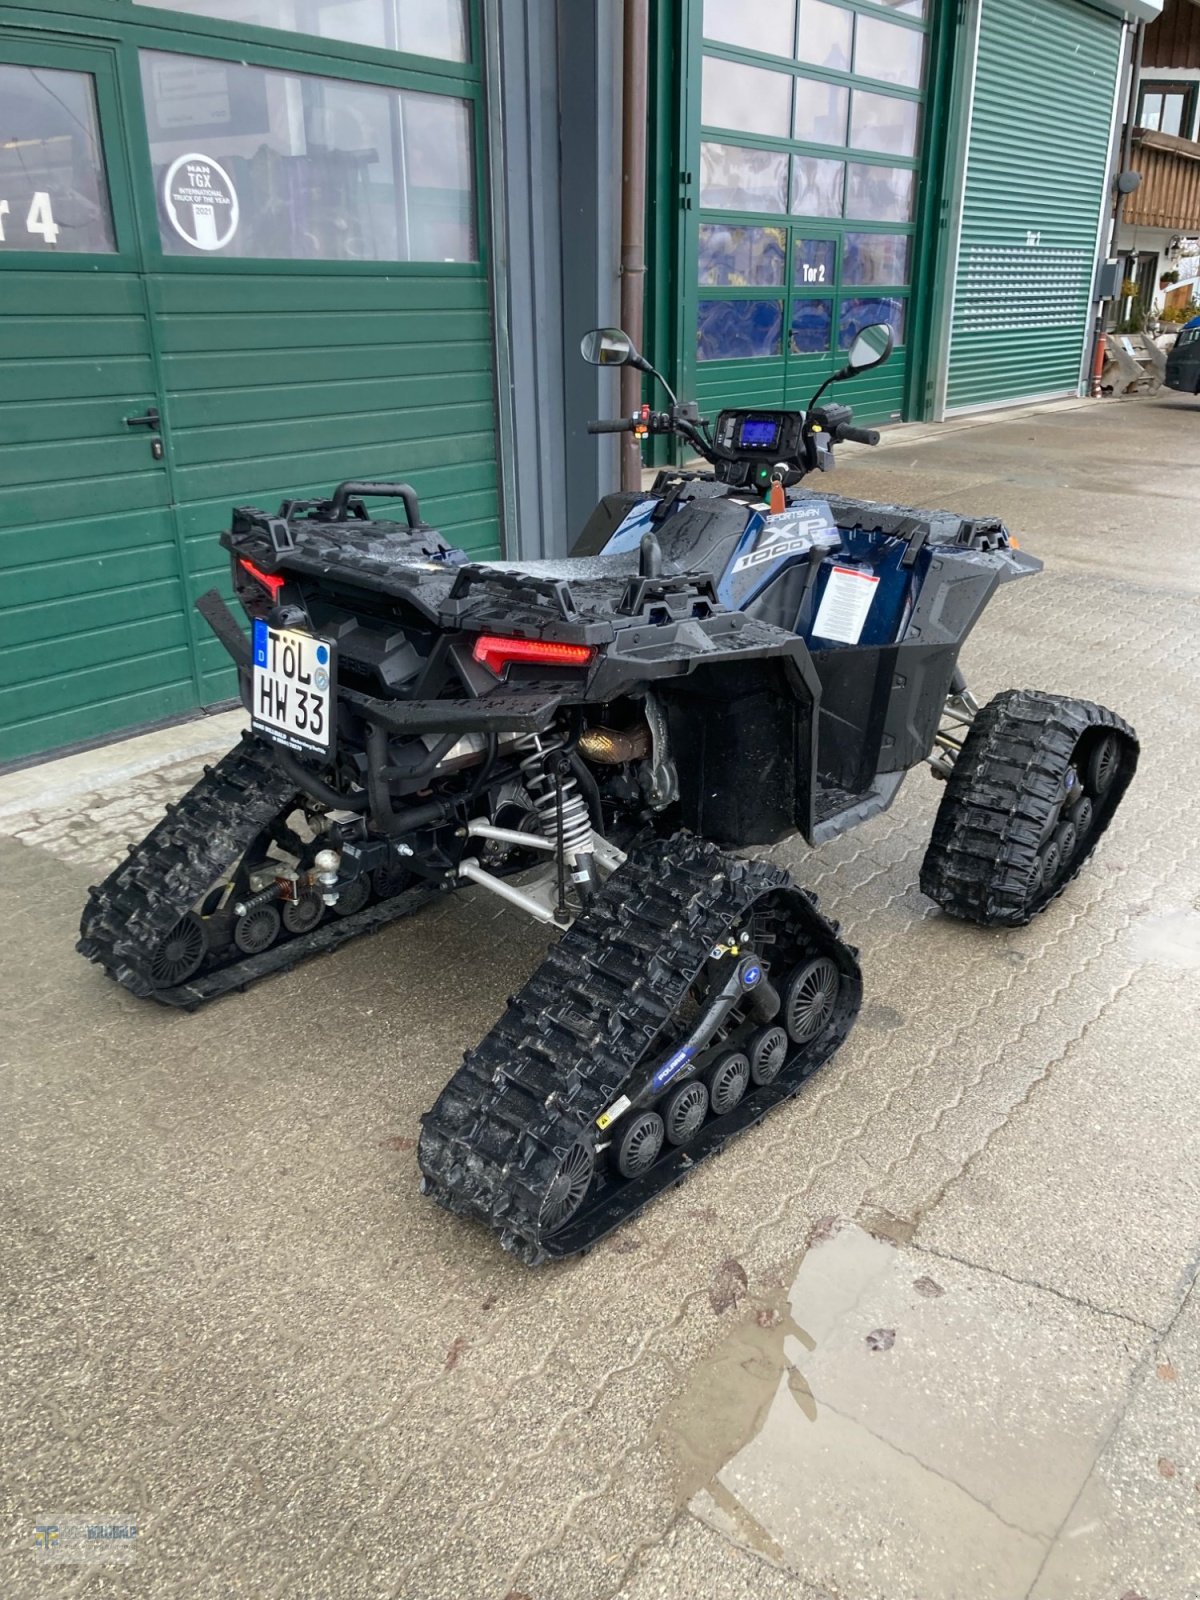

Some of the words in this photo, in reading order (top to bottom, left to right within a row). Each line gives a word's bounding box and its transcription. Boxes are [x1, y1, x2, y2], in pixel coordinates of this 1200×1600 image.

[187, 165, 210, 174] MAN
[188, 172, 211, 188] TGX
[173, 194, 193, 203] TRUCK
[193, 195, 203, 203] OF
[203, 196, 215, 204] THE
[215, 197, 231, 205] YEAR
[179, 187, 223, 198] INTERNATIONAL
[26, 191, 60, 244] 4
[195, 206, 212, 215] 2021
[803, 264, 818, 282] Tor
[818, 264, 826, 282] 2
[766, 508, 820, 524] SPORTSMAN
[757, 518, 828, 550] XP
[742, 540, 804, 568] 1000
[269, 631, 312, 686] TÖL
[261, 674, 288, 723] HW
[295, 687, 324, 736] 33
